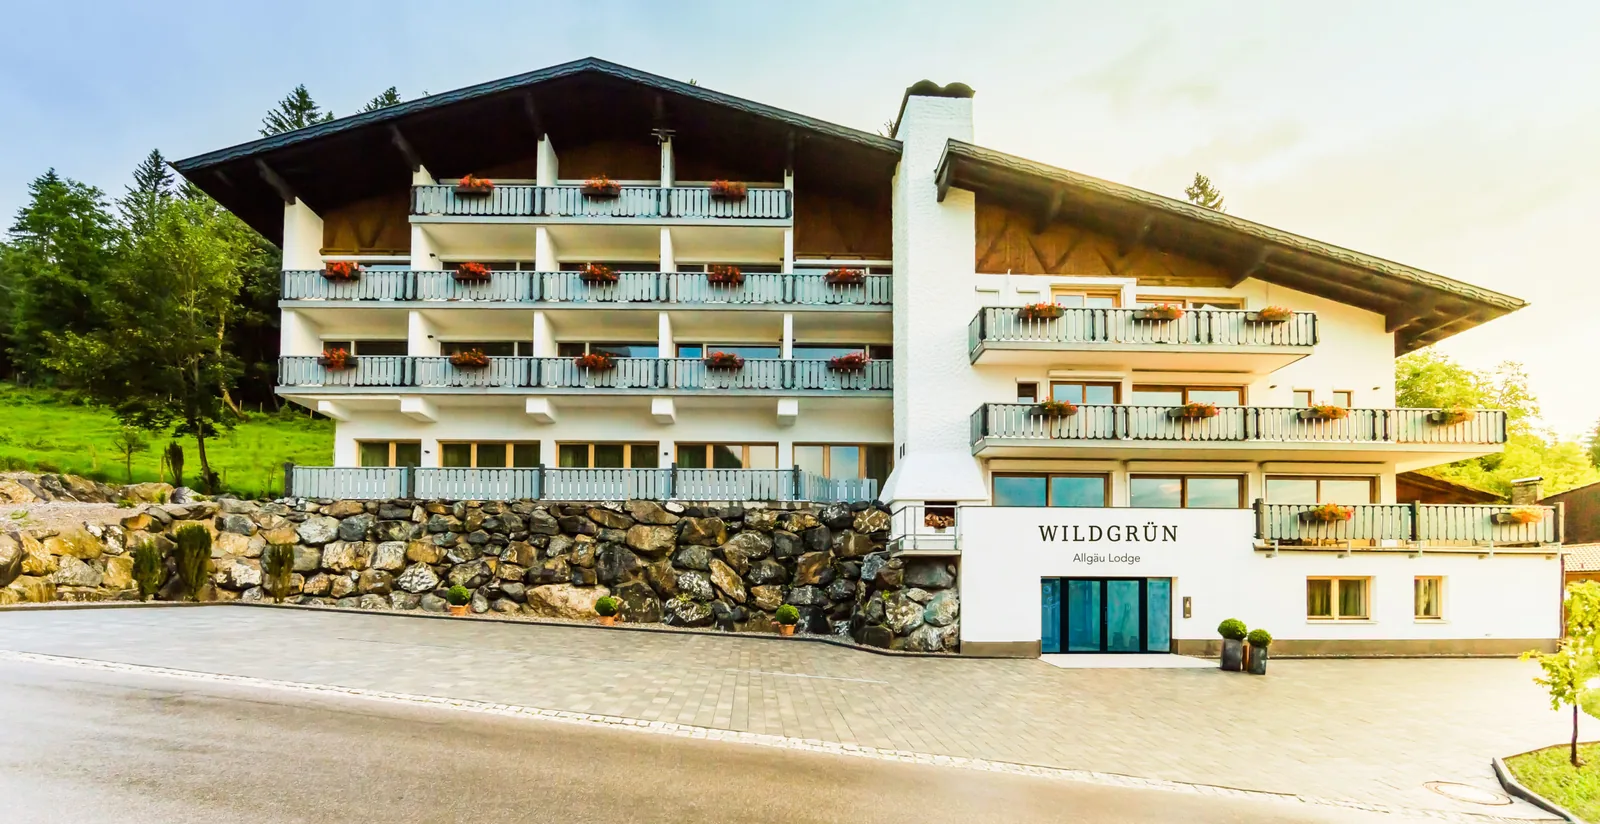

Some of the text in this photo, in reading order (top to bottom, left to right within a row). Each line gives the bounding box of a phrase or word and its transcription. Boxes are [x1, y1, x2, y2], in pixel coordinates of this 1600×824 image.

[1038, 521, 1178, 542] WILDGRÜN
[1072, 553, 1141, 565] Allgäu Lodge
